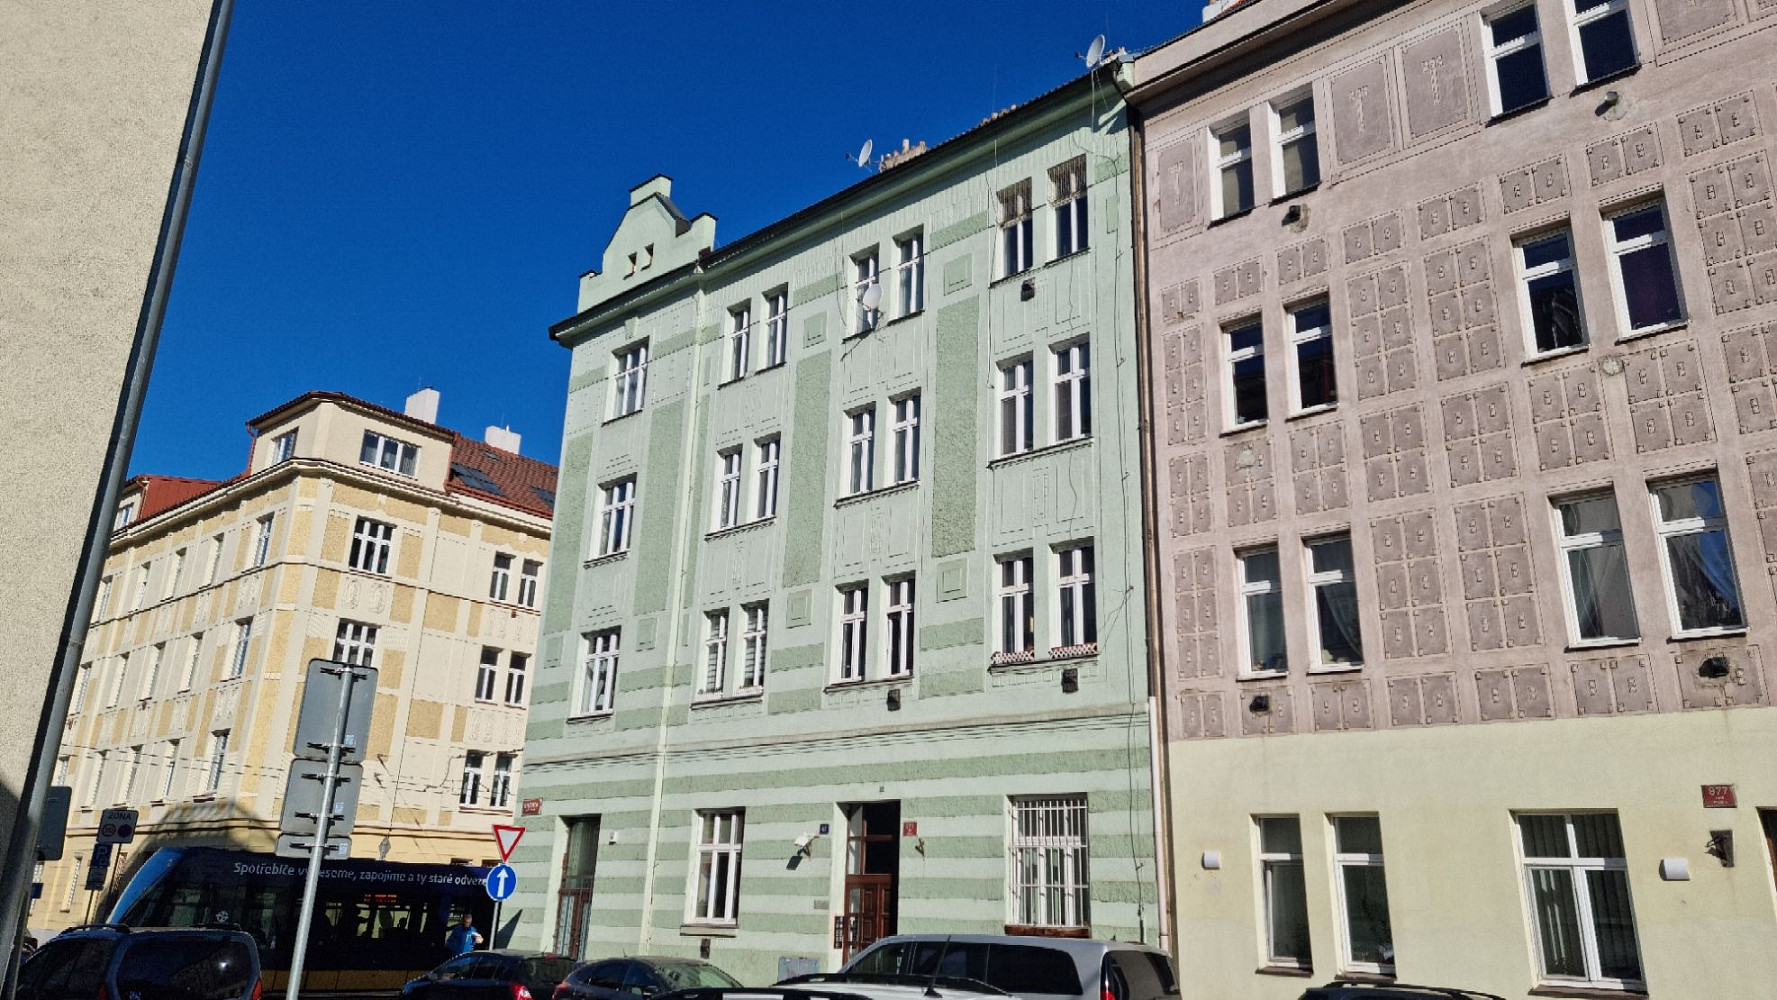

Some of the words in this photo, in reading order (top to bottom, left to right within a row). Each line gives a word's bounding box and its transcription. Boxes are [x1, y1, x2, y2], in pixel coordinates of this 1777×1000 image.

[233, 862, 296, 876] Spotřebiče
[298, 867, 357, 882] veseme,
[408, 874, 415, 882] a
[416, 873, 427, 885] ty
[428, 873, 453, 884] staré
